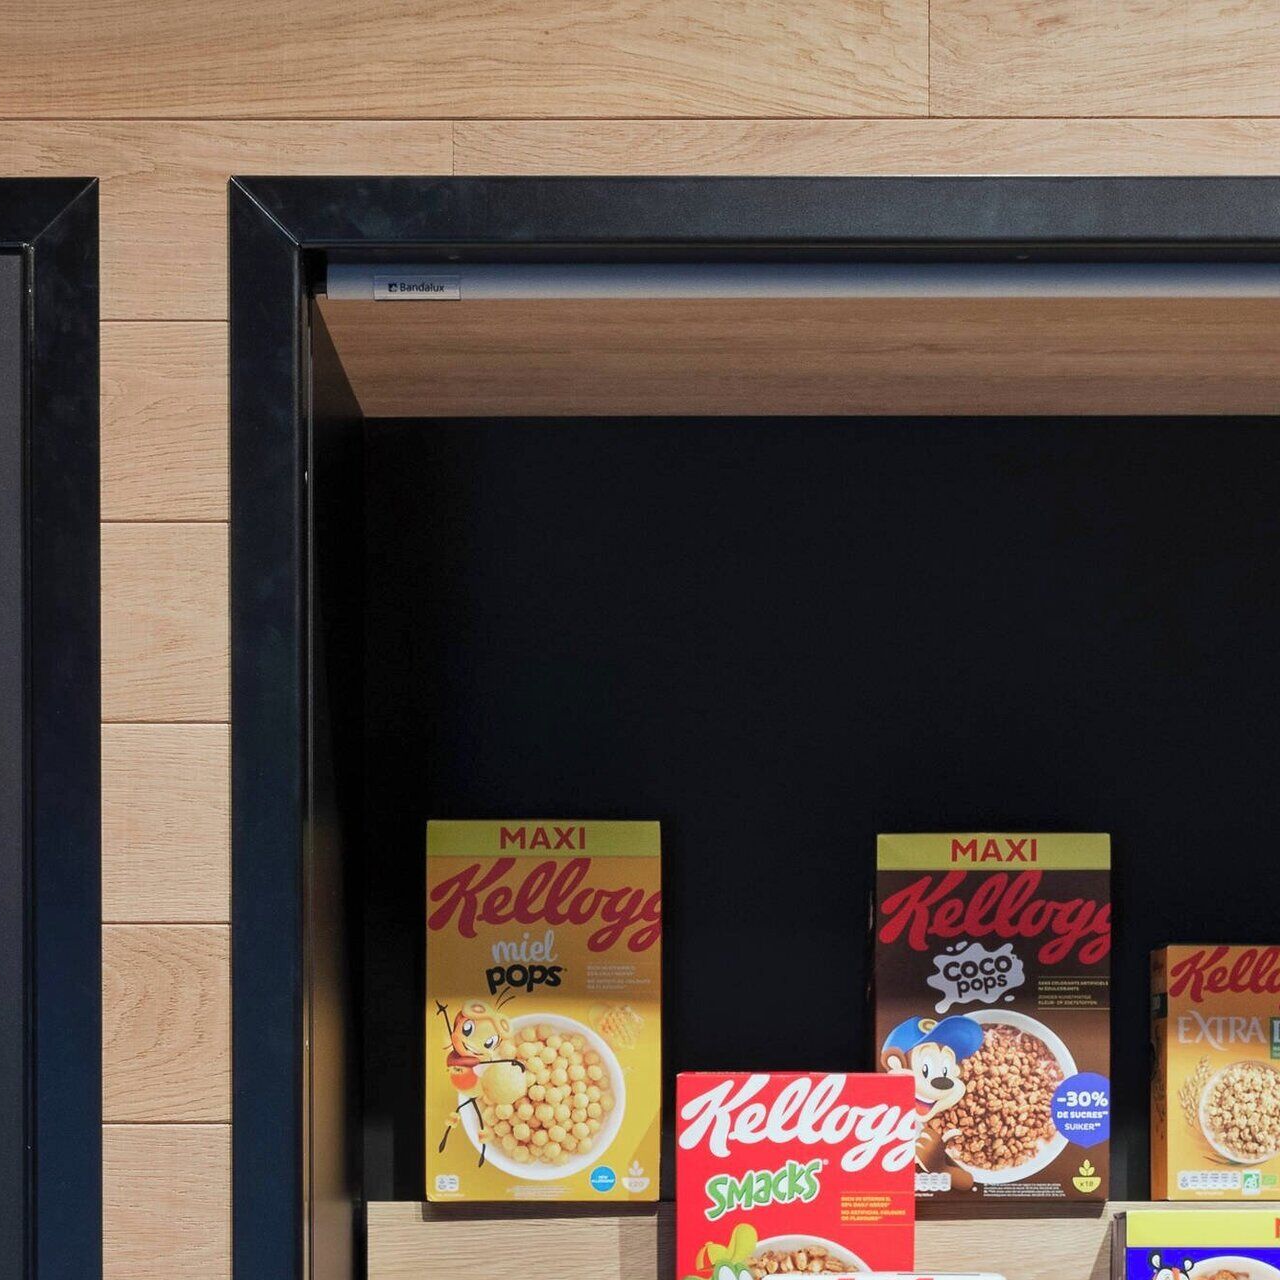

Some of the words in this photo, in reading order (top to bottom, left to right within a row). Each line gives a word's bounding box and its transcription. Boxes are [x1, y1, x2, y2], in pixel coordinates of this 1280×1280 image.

[400, 282, 445, 292] Bandalux
[499, 826, 586, 850] MAXI
[951, 838, 1037, 862] MAXI
[491, 930, 558, 963] miel
[485, 964, 563, 995] pops
[956, 974, 1008, 999] pops
[1177, 1011, 1267, 1051] EXTRA
[1056, 1091, 1109, 1107] -30%
[1057, 1111, 1069, 1119] DE
